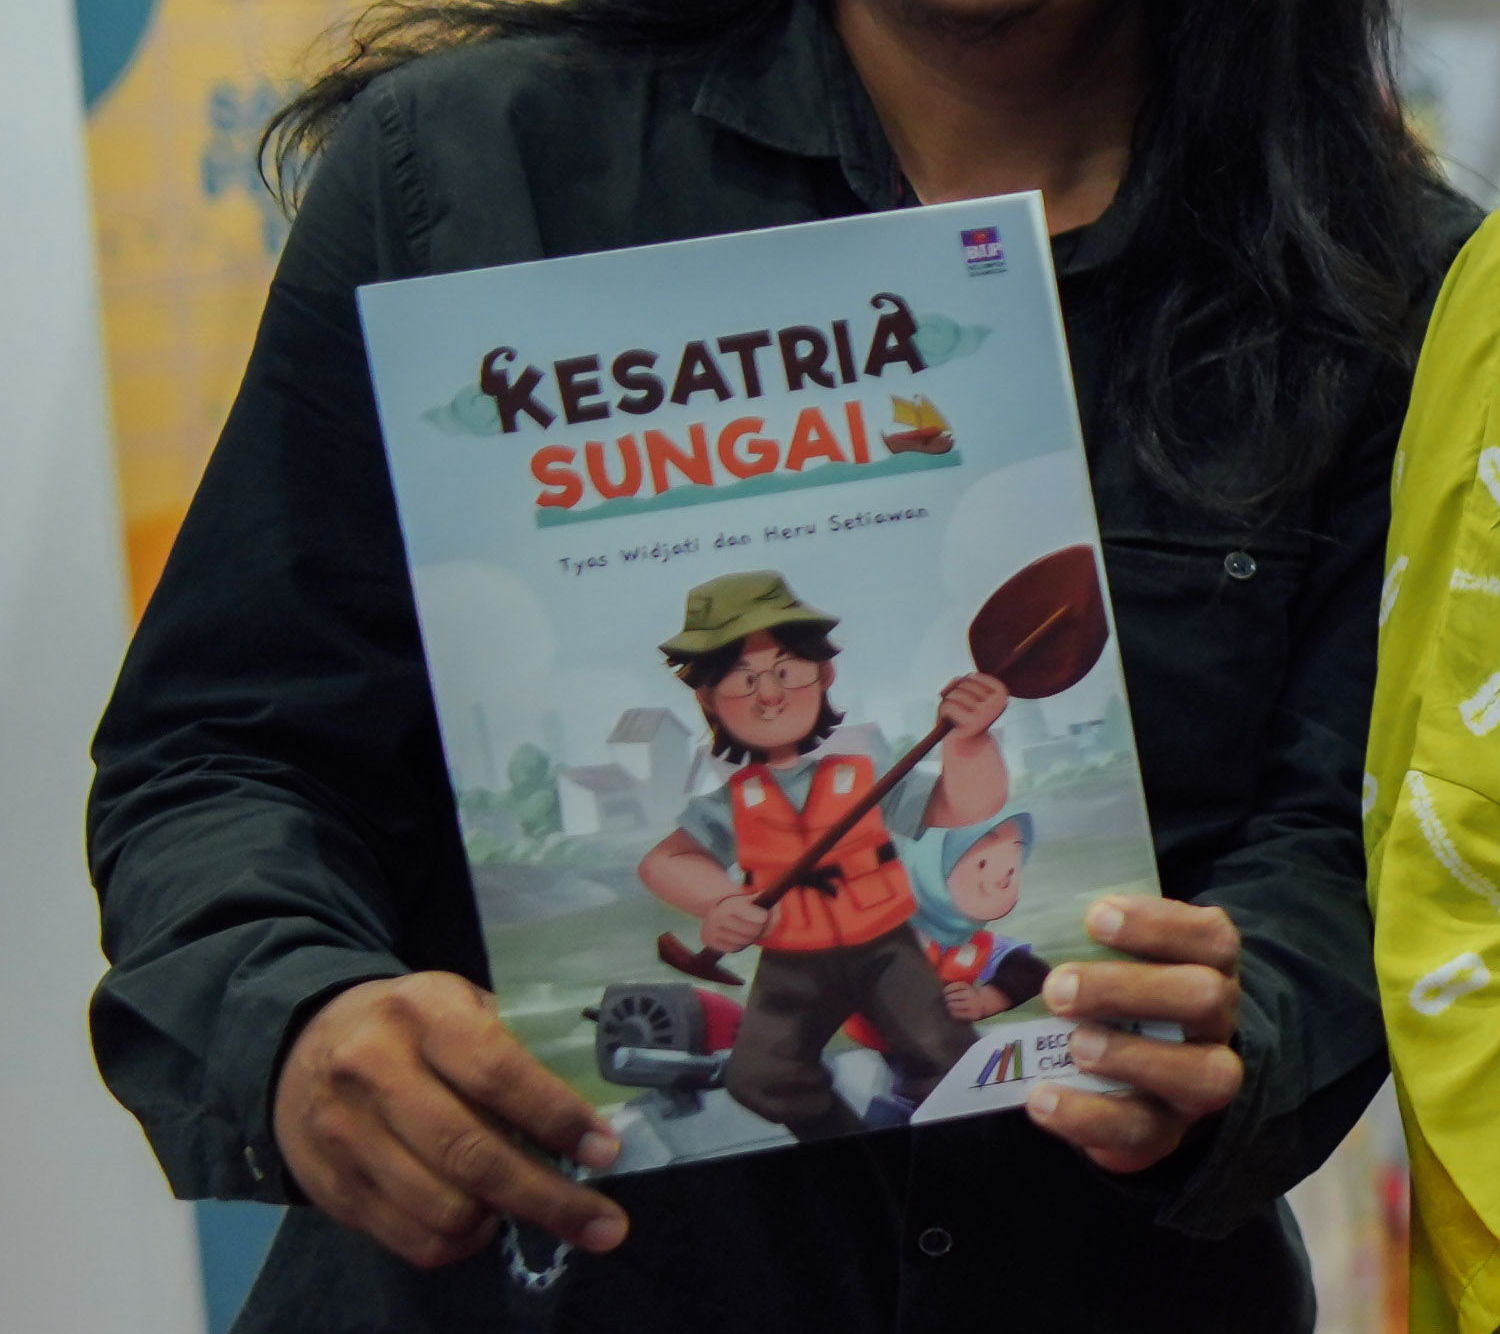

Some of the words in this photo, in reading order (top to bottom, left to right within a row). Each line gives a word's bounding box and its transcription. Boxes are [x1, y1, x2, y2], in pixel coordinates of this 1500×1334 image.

[480, 291, 929, 434] KESATRIA
[530, 400, 872, 510] SUNGAI
[558, 554, 609, 576] Tyas
[619, 537, 701, 563] Widjati
[713, 531, 752, 551] dan
[763, 524, 817, 543] Heru
[827, 505, 930, 533] Setiawan
